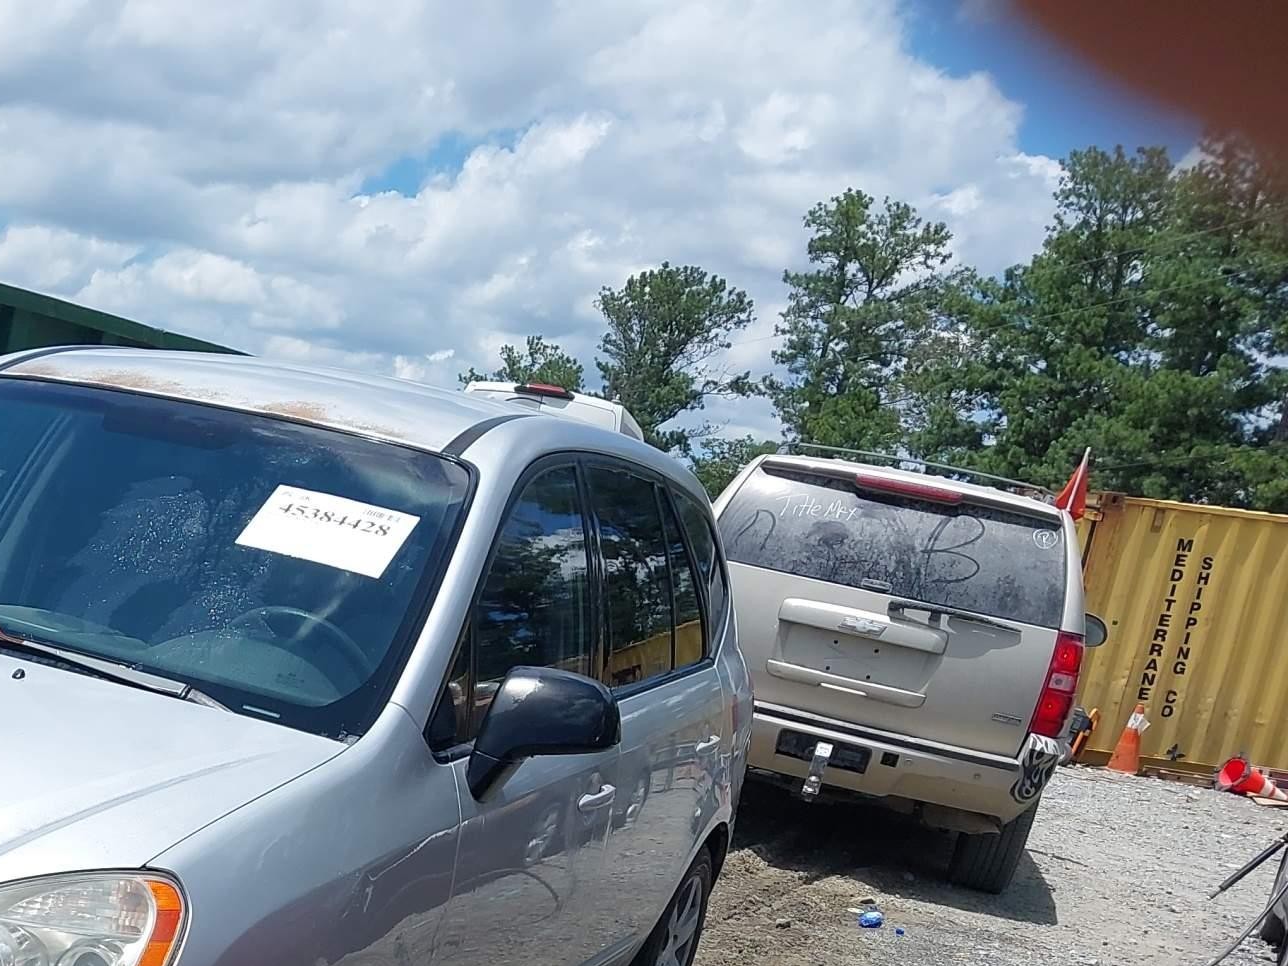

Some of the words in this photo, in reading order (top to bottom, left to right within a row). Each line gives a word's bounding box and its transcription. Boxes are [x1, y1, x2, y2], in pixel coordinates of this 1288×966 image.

[278, 502, 392, 537] 45384428
[1172, 556, 1214, 675] SHIPPING
[1161, 689, 1178, 719] CO
